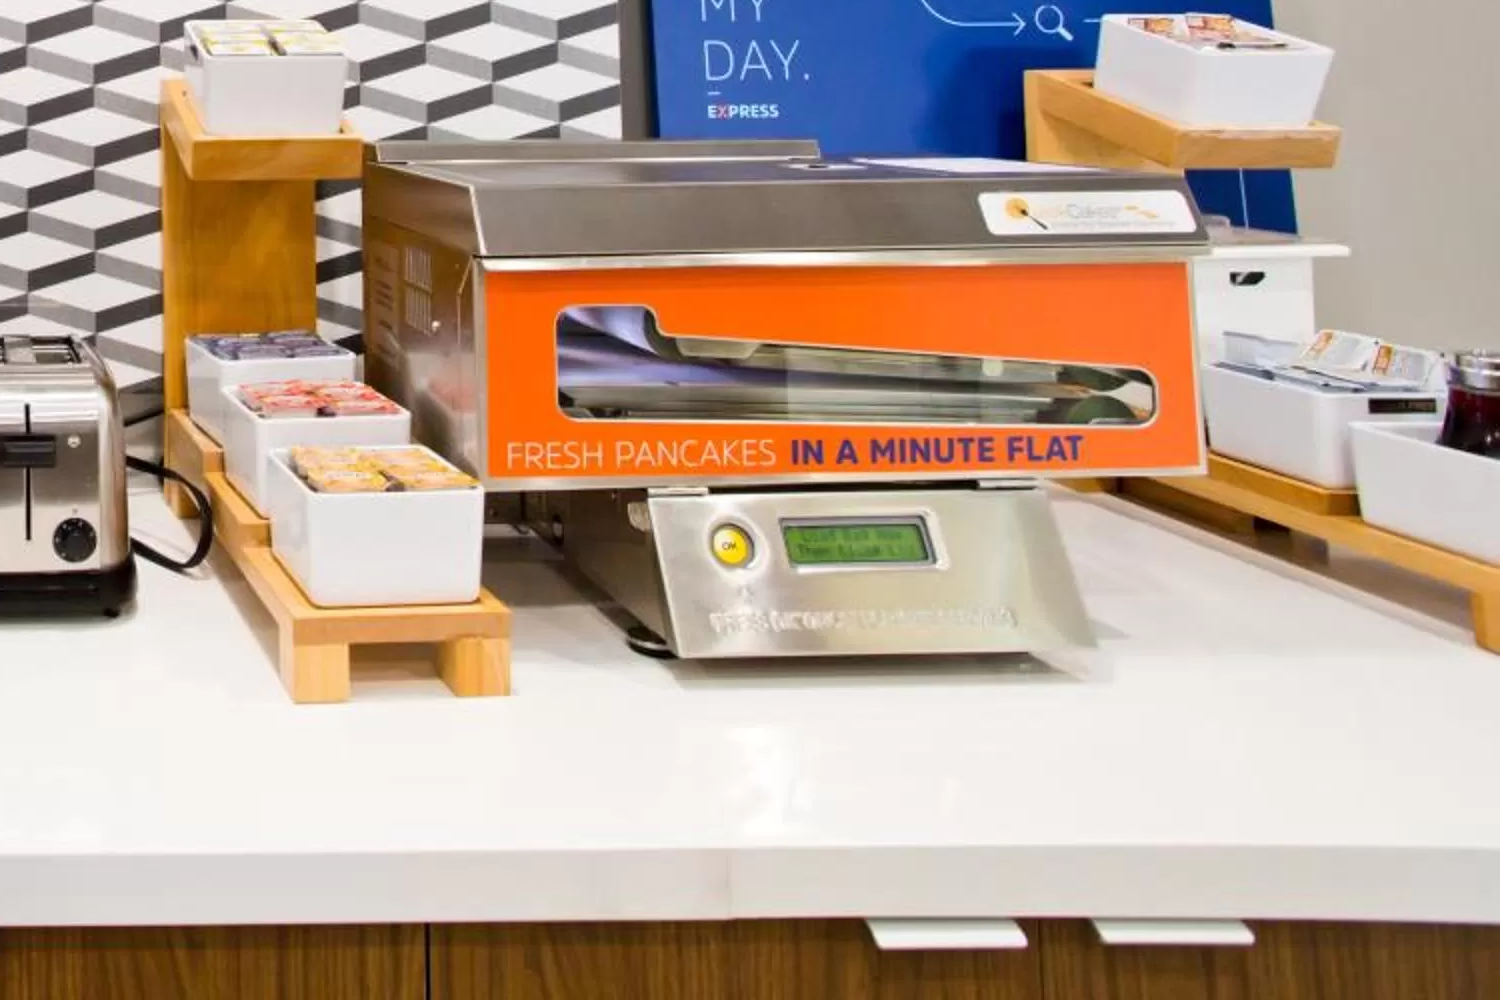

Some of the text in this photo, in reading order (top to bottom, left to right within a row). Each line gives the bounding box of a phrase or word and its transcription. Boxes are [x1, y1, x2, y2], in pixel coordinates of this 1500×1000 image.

[703, 39, 810, 81] DAY.
[707, 104, 780, 119] EXPRESS
[506, 435, 1083, 470] FRESH PANCAKES IN A MINUTE FLAT
